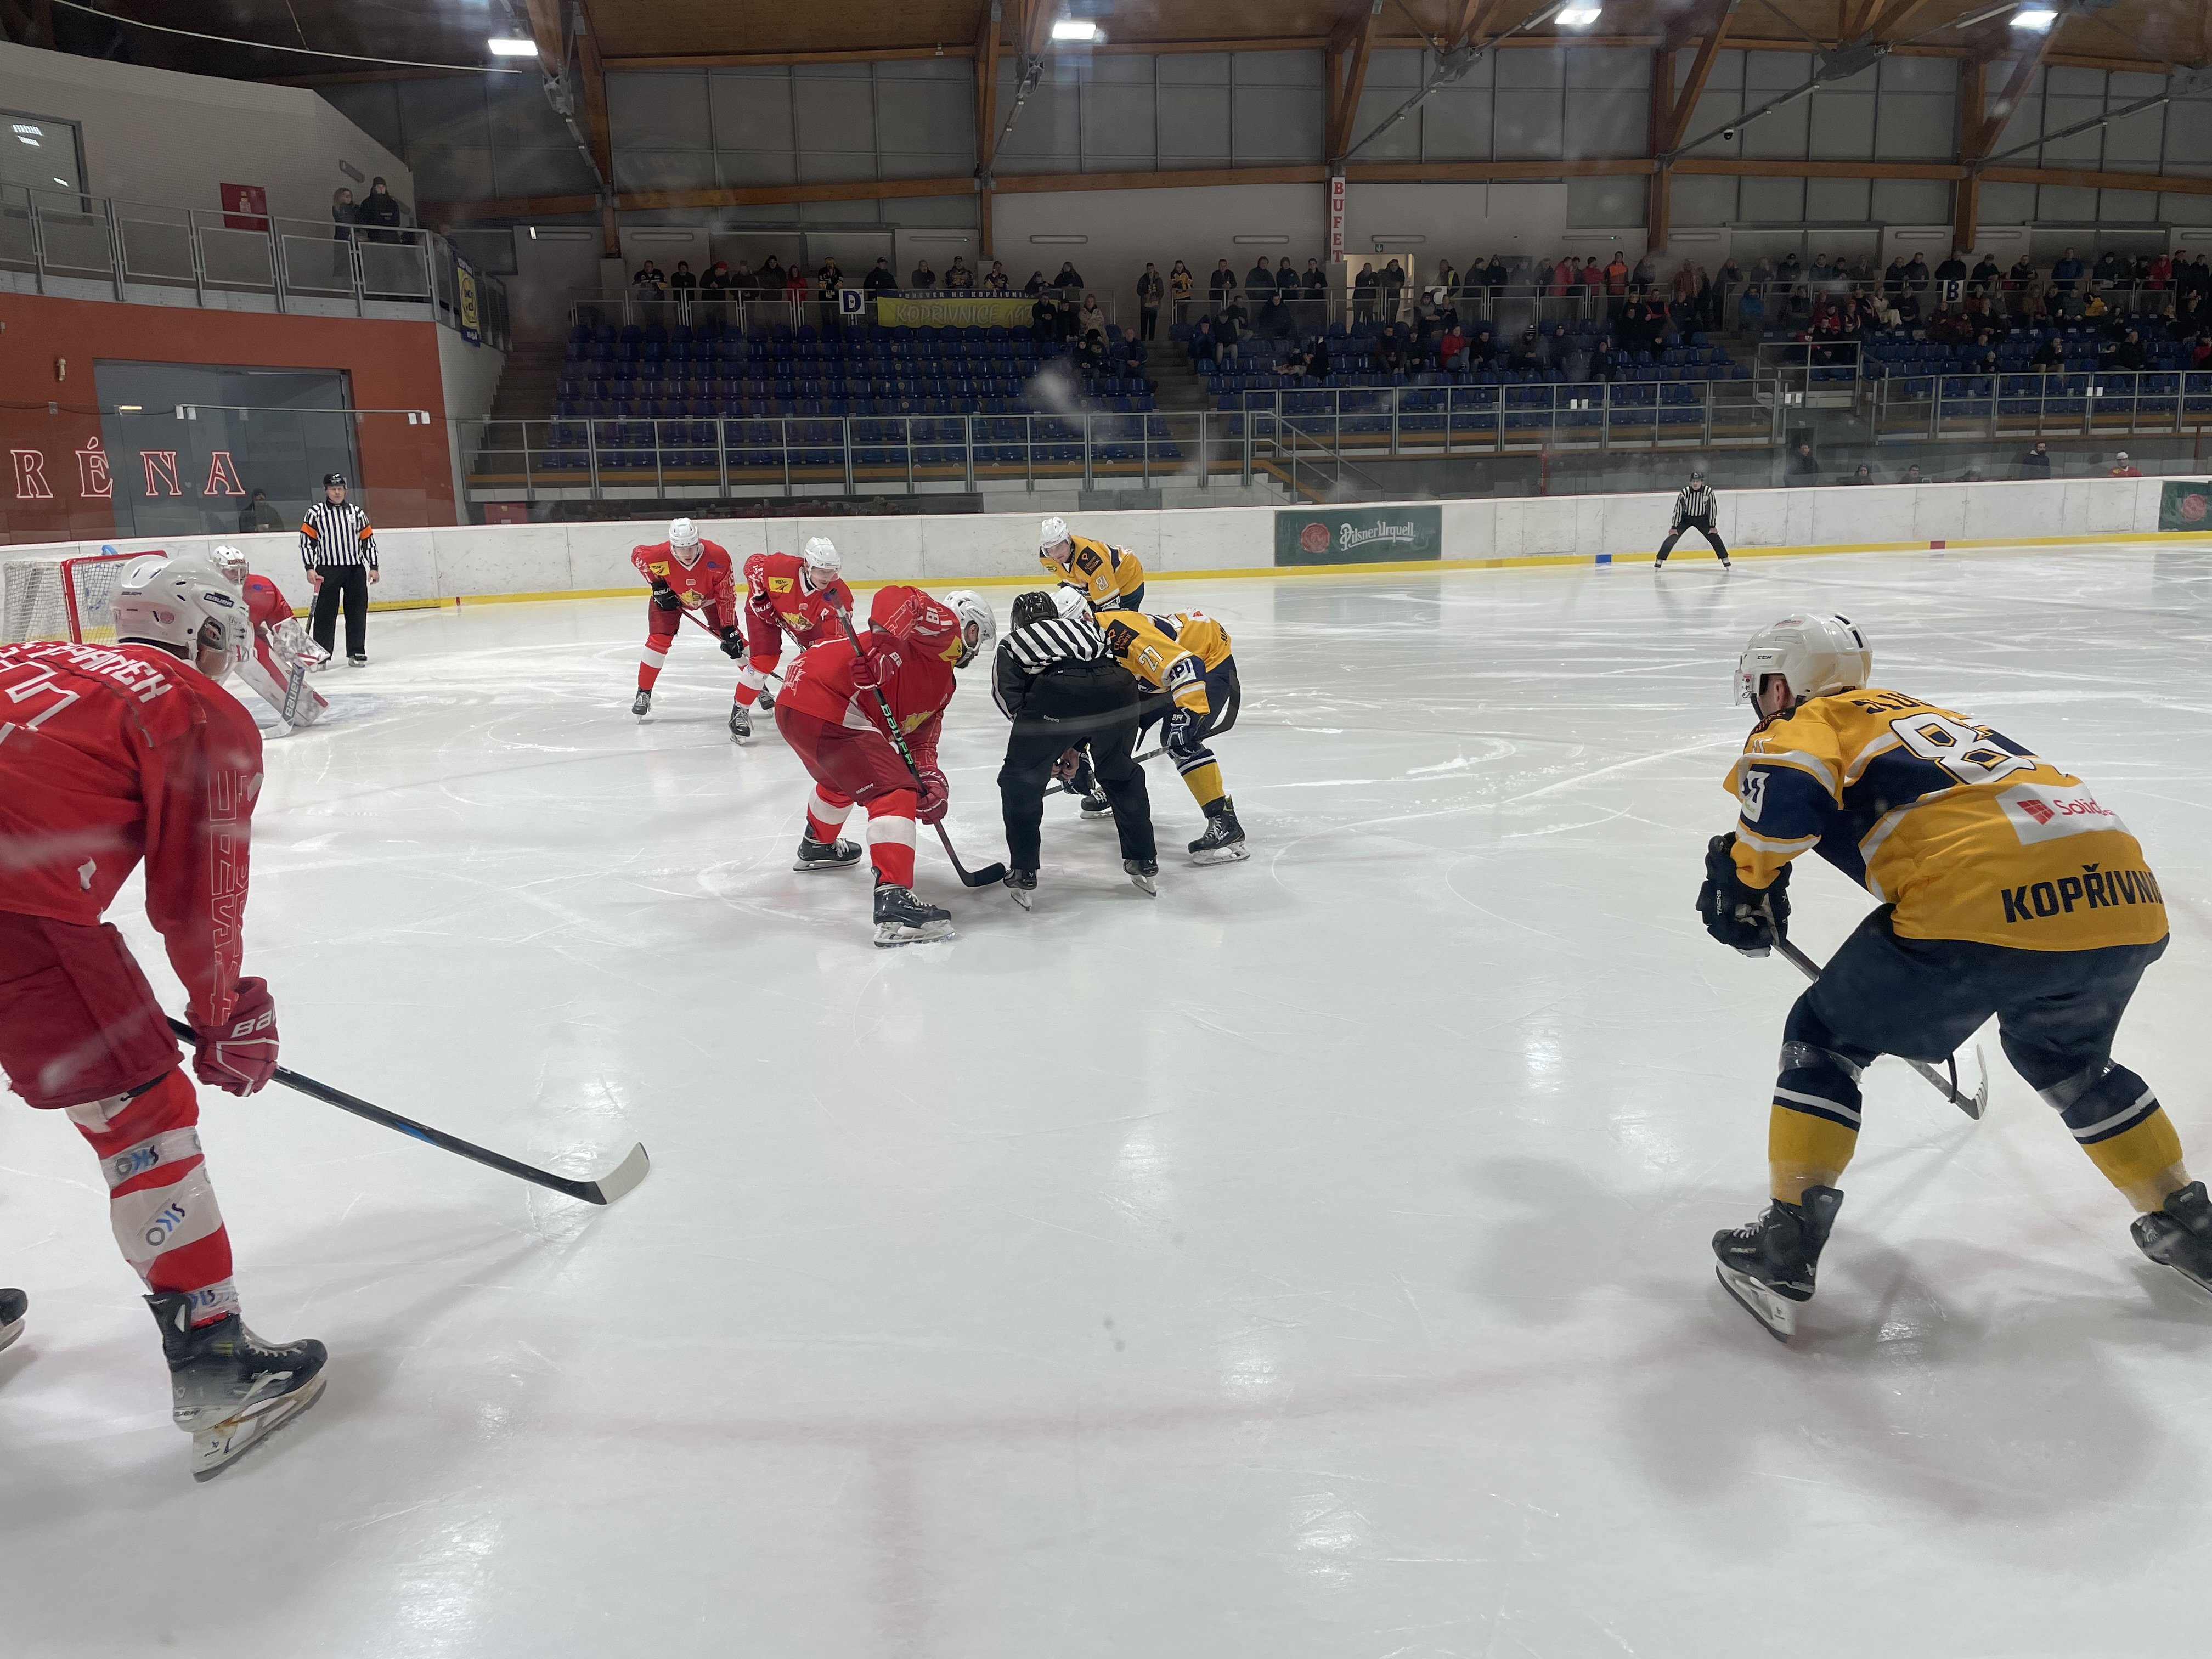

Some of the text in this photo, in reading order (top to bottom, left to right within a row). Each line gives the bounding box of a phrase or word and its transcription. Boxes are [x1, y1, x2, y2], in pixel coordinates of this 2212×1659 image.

[1333, 182, 1344, 263] BUFET
[843, 290, 861, 313] D
[1946, 281, 1959, 301] B
[895, 302, 1000, 325] KOPŘIVNICE
[1339, 520, 1415, 551] Pilsner Urquell
[1138, 644, 1163, 672] 27
[285, 674, 301, 718] BAUER
